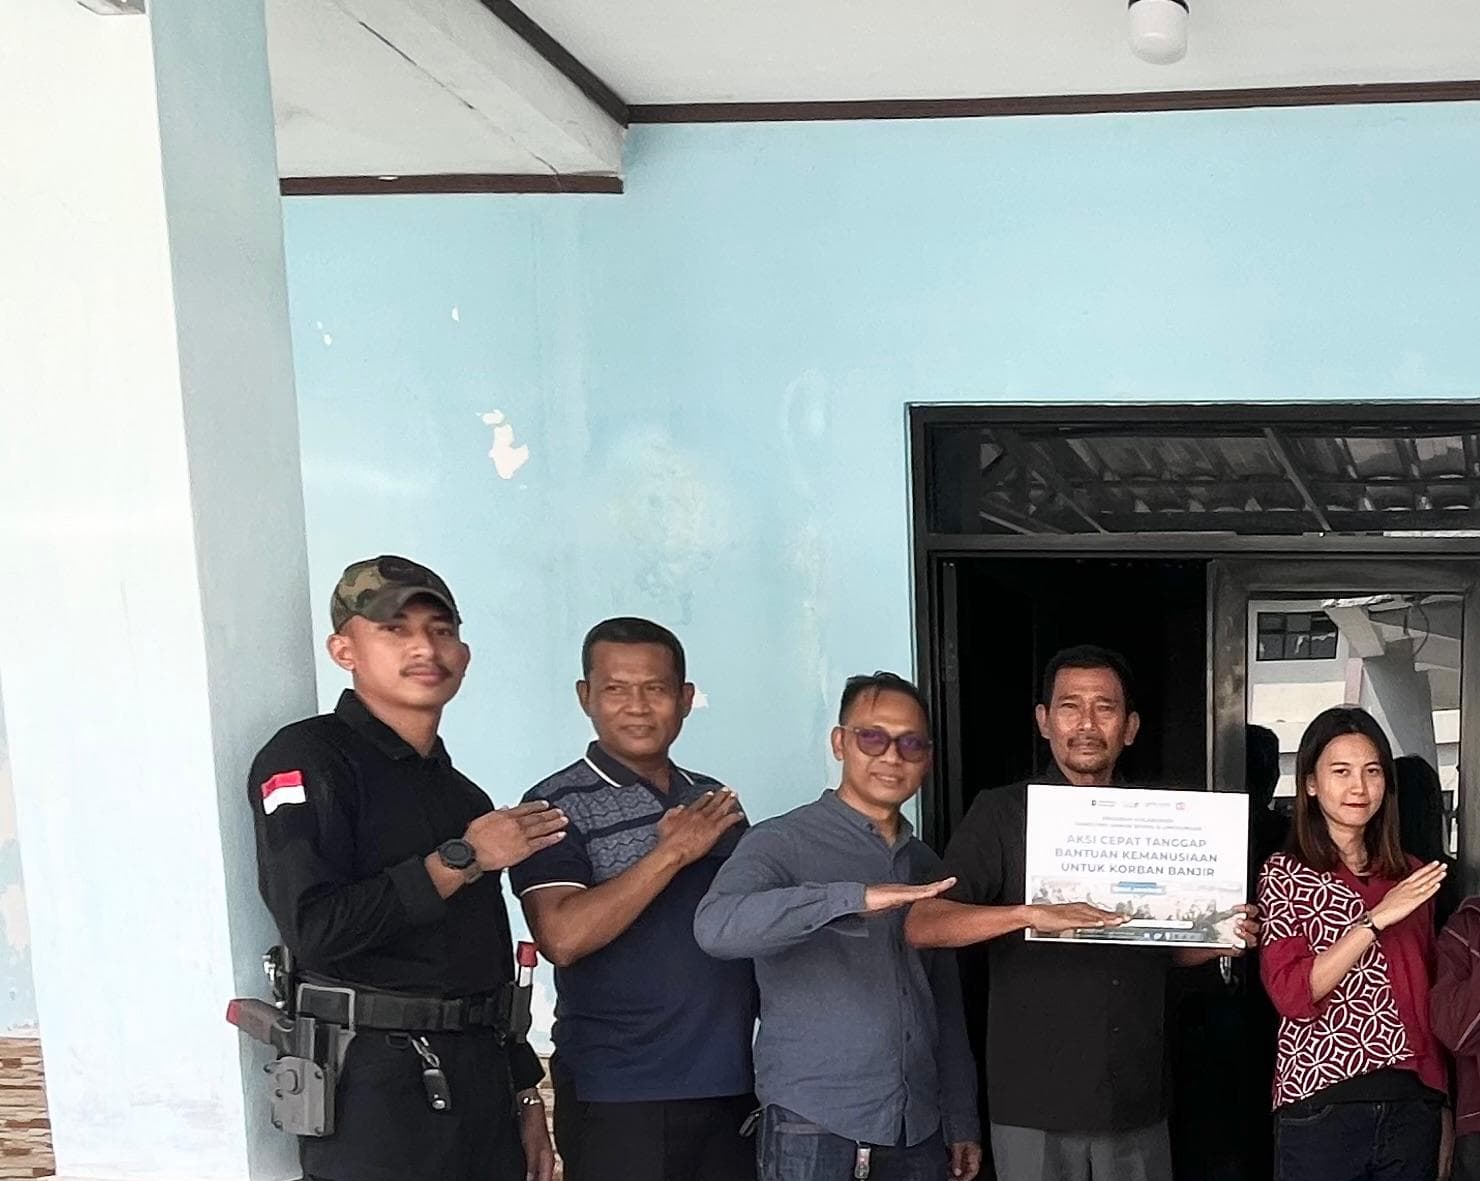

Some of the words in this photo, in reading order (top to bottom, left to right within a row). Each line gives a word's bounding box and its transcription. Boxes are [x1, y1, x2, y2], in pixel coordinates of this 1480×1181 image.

[1067, 834, 1097, 845] AKSI
[1101, 836, 1140, 847] CEPAT
[1146, 837, 1206, 848] TANGGAP
[1055, 848, 1118, 860] BANTUAN
[1123, 850, 1217, 862] KEMANUSIAAN
[1061, 863, 1105, 873] UNTUK
[1110, 864, 1164, 875] KORBAN
[1169, 866, 1214, 876] BANJIR
